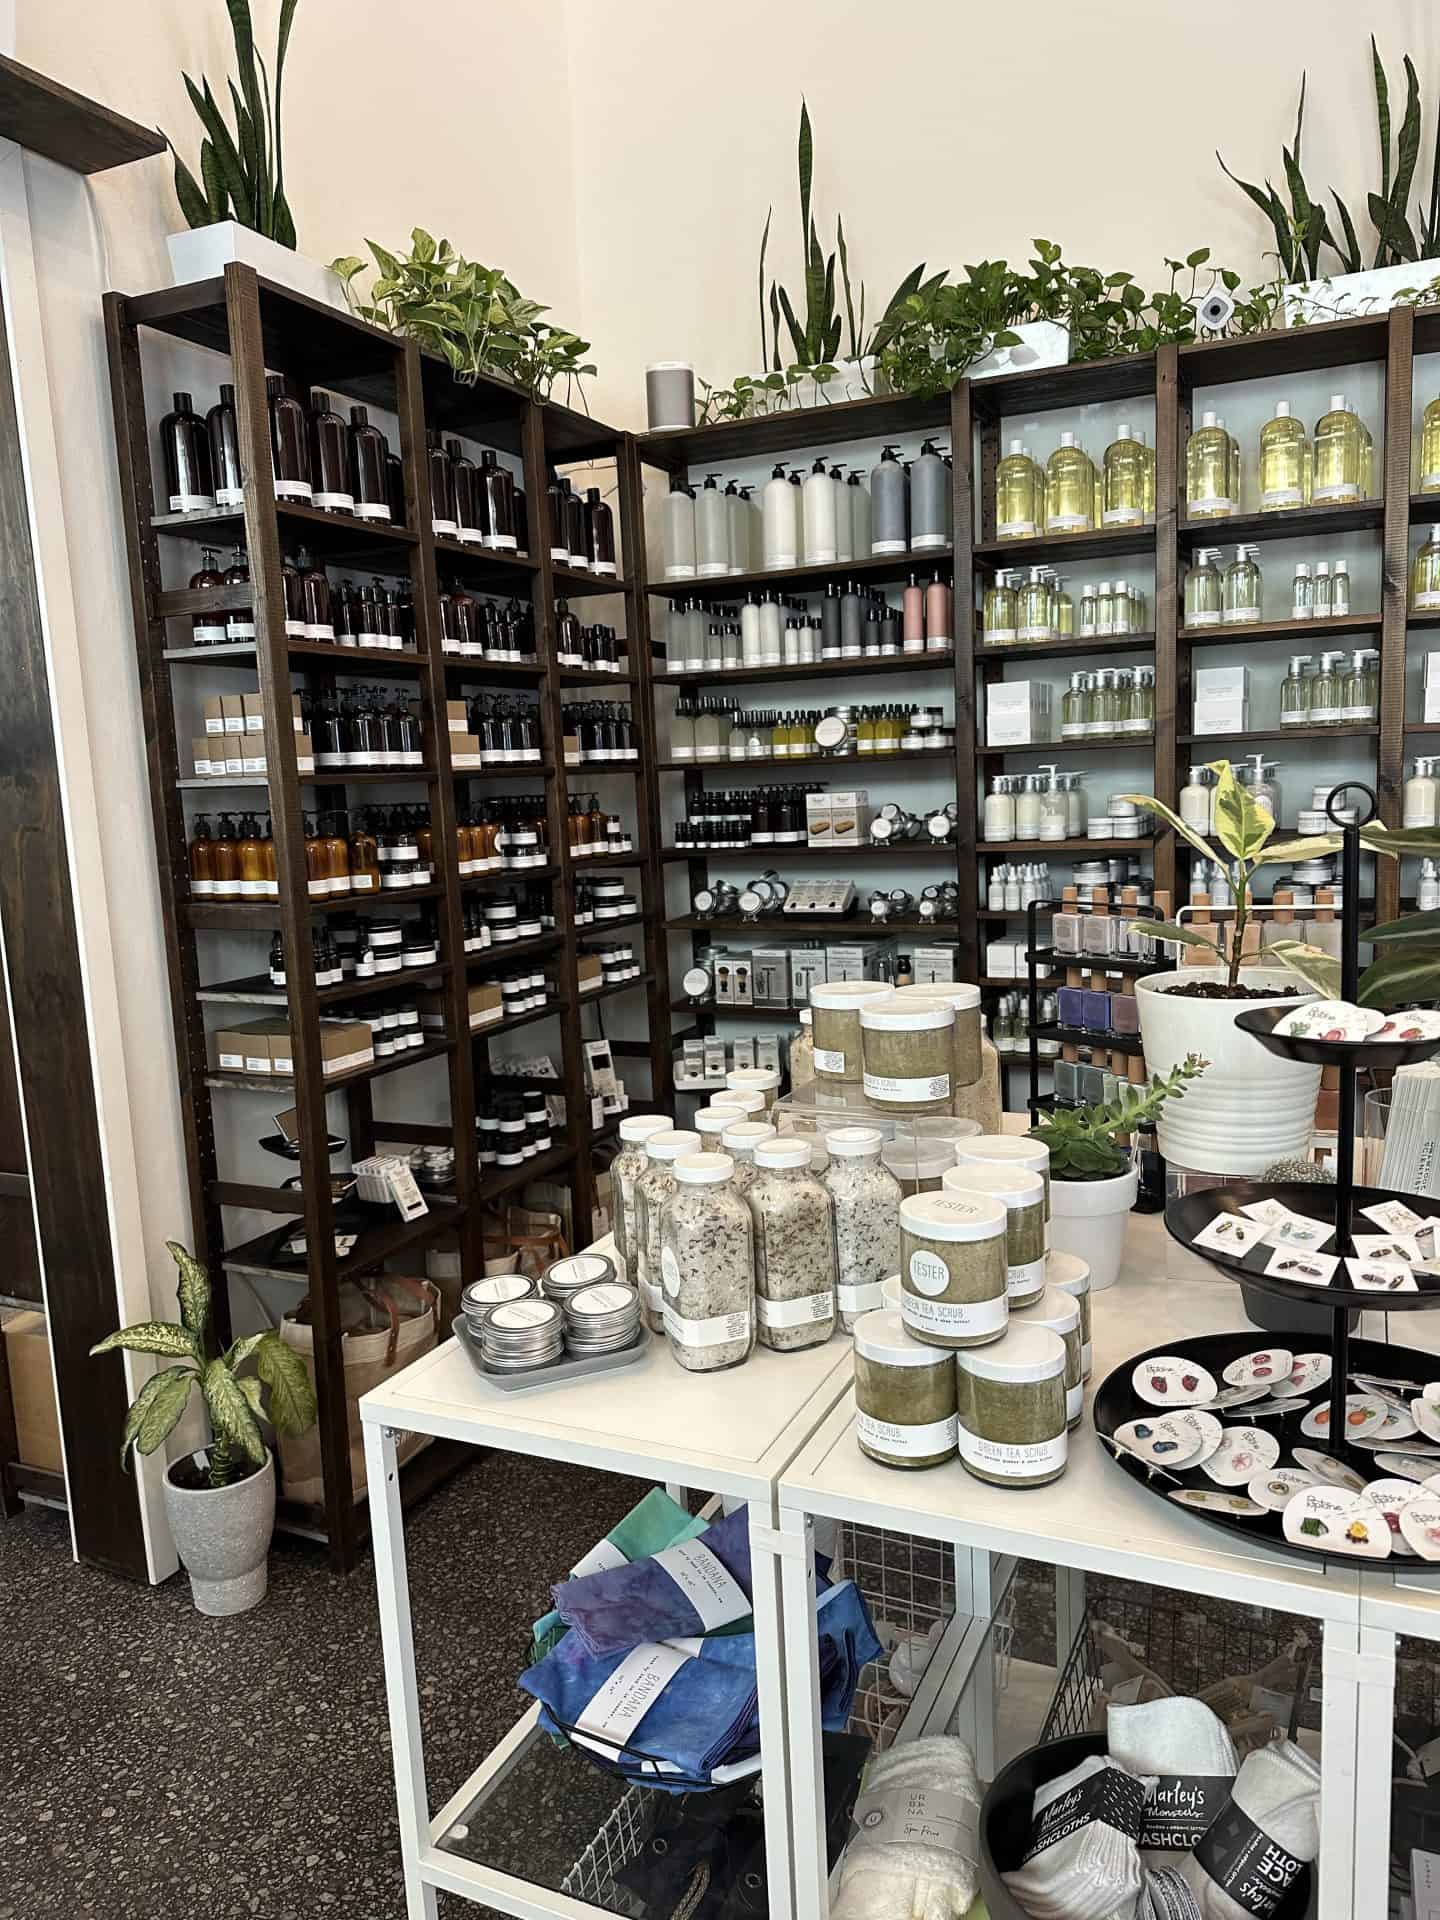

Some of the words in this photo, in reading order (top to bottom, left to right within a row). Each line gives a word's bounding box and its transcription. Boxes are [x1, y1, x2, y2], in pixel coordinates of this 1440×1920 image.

[934, 1199, 978, 1215] TESTER
[913, 1260, 946, 1281] TESTER
[921, 1303, 934, 1315] TEA
[937, 1306, 964, 1319] SCRUB
[1006, 1446, 1021, 1458] TEA
[1024, 1445, 1049, 1458] SCRUB
[694, 1553, 728, 1588] BANDANA
[621, 1672, 661, 1719] BANDANA
[1143, 1780, 1206, 1809] Marley's
[1256, 1856, 1294, 1888] ACE
